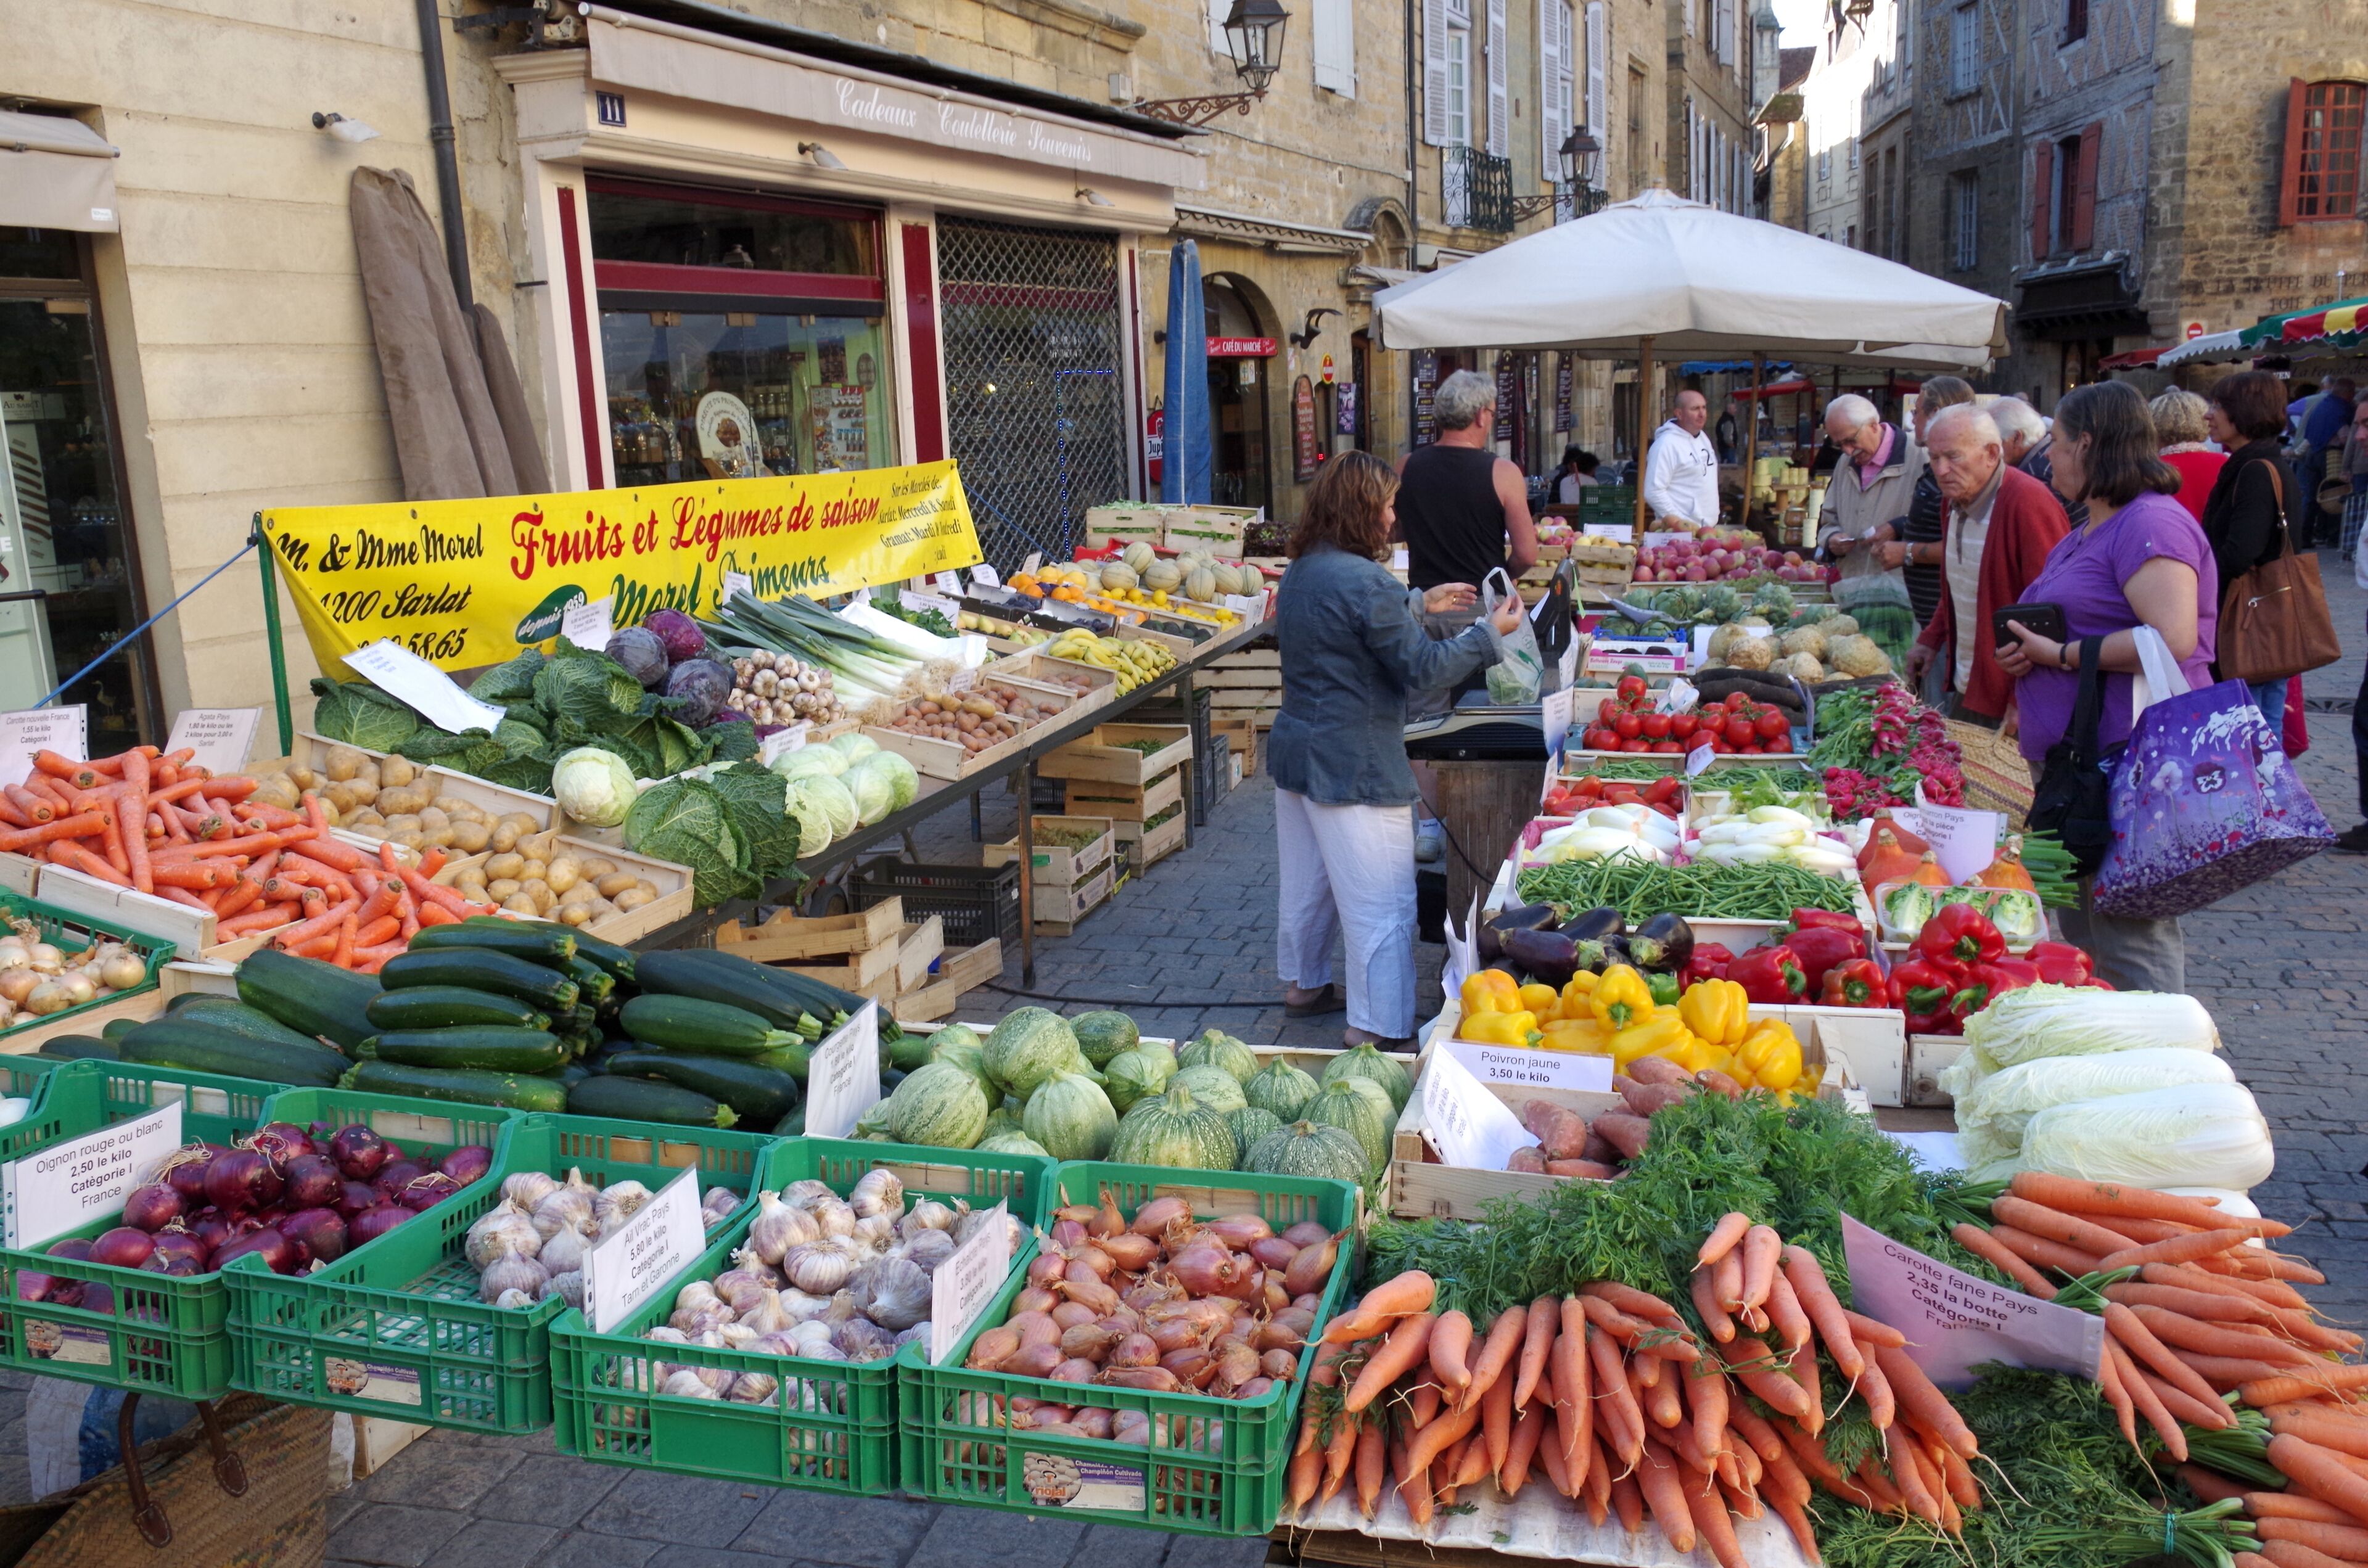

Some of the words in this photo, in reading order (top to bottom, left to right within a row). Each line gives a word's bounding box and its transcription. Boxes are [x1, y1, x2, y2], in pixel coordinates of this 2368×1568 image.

[605, 96, 622, 122] 11
[836, 78, 918, 128] Cadeaux
[937, 101, 1018, 147] Coutellerie
[1028, 120, 1092, 162] Souvenirs
[1222, 339, 1234, 353] CAFÉ
[1235, 341, 1243, 353] DU
[1243, 339, 1262, 353] MARCHÉ
[898, 500, 932, 522] Mercredi
[929, 499, 939, 514] &
[318, 533, 352, 573] &
[355, 528, 420, 570] Mme
[420, 522, 484, 564] Morel
[510, 509, 626, 581] Fruits
[631, 509, 659, 556] et
[669, 496, 784, 563] Légumes
[786, 490, 814, 533] de
[820, 486, 880, 530] saison
[880, 528, 915, 549] Gramat:
[911, 522, 937, 540] Mardi
[380, 581, 472, 619] Sarlat
[517, 605, 562, 638] depuis
[562, 591, 585, 614] 1959
[51, 713, 70, 721] France
[1944, 812, 1965, 824] Pays
[1481, 1051, 1526, 1067] Poivron
[1527, 1054, 1561, 1070] jaune
[1489, 1067, 1513, 1080] 3,50
[1516, 1070, 1526, 1081] le
[1529, 1071, 1550, 1083] kilo
[36, 1150, 77, 1175] Oignon
[80, 1138, 116, 1157] rouge
[118, 1131, 134, 1145] ou
[136, 1119, 163, 1139] blanc
[70, 1159, 94, 1178] 2,50
[97, 1156, 108, 1168] le
[110, 1148, 133, 1164] kilo
[70, 1164, 126, 1195] Catègorie
[81, 1185, 122, 1209] France
[624, 1231, 635, 1248] Ail
[651, 1202, 670, 1225] Pays
[630, 1239, 645, 1262] 5,80
[653, 1223, 667, 1242] kilo
[621, 1287, 640, 1308] Tarn
[641, 1278, 649, 1293] et
[649, 1251, 681, 1285] Garonne
[1883, 1243, 1944, 1281] Carotte
[1947, 1274, 1987, 1299] fane
[1991, 1291, 2039, 1316] Pays
[1907, 1270, 1939, 1296] 2,35
[1943, 1288, 1959, 1305] la
[1962, 1297, 2009, 1322] botte
[1080, 1467, 1114, 1476] Champiñón
[1114, 1469, 1143, 1477] Cultivado
